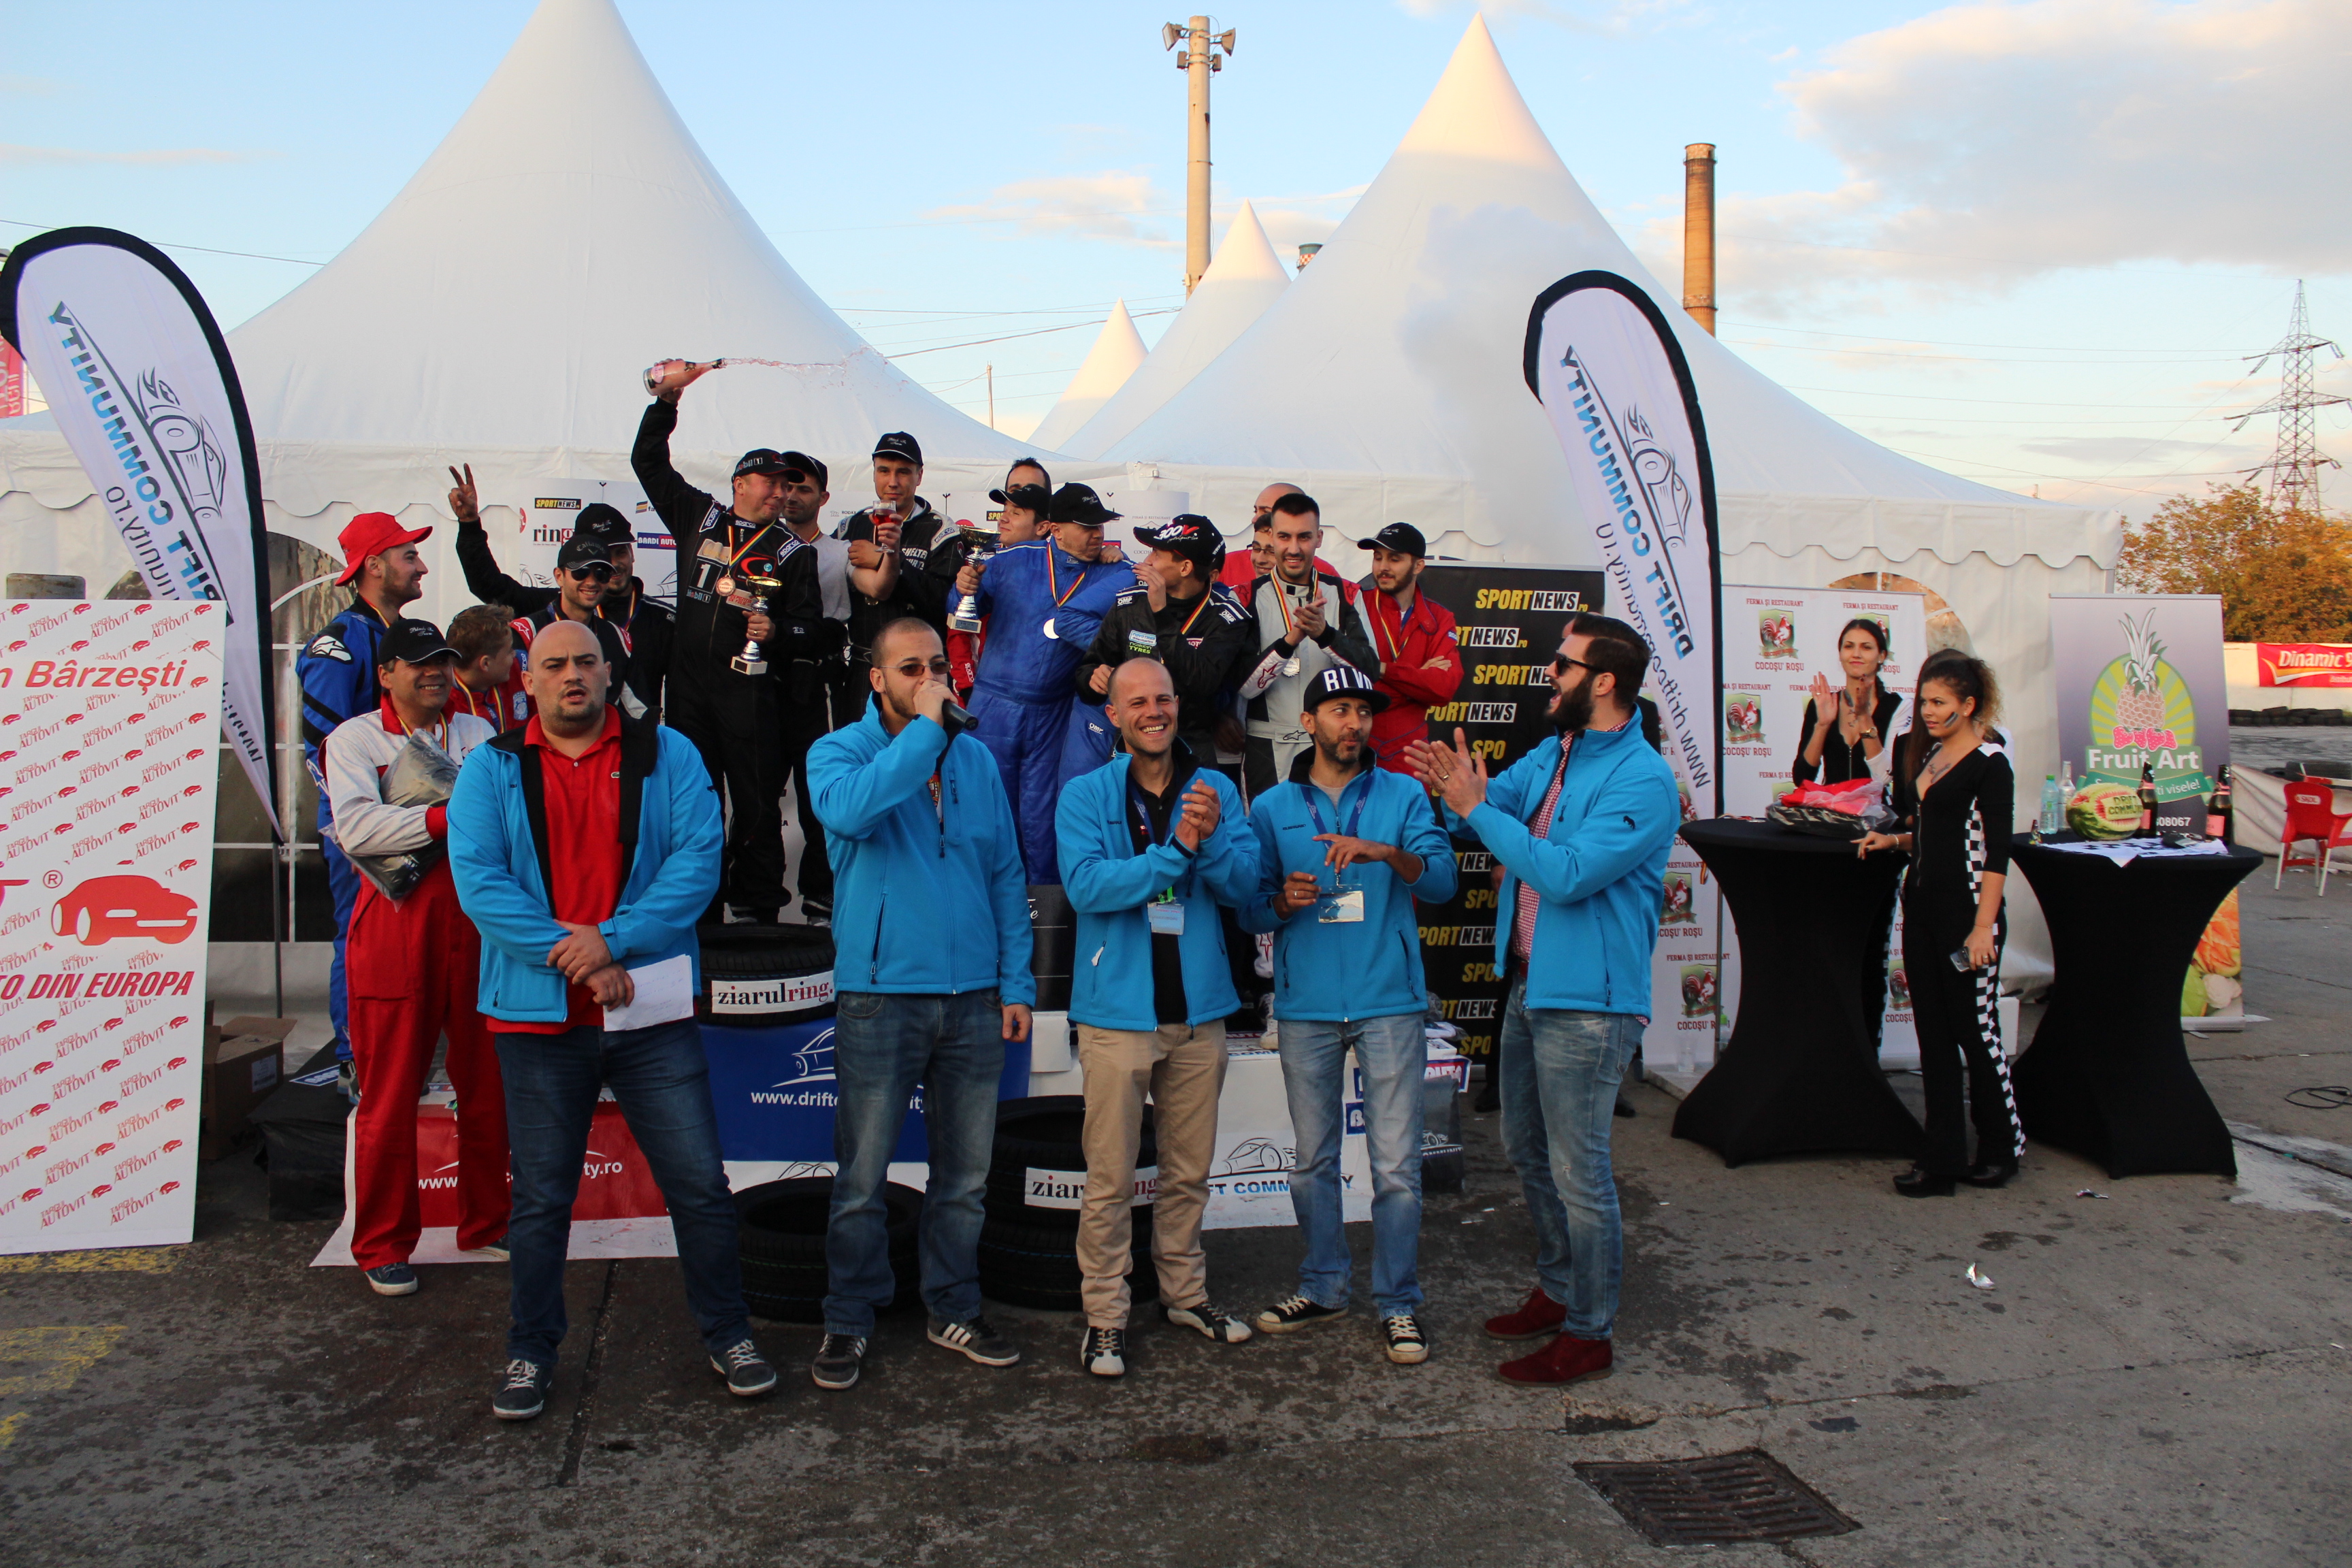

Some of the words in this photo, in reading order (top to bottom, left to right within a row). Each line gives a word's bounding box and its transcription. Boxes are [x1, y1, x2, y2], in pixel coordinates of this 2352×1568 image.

[735, 520, 756, 528] sparco
[780, 540, 800, 556] sparco
[697, 563, 711, 589] 1
[1117, 596, 1132, 606] OMP
[28, 616, 51, 630] TARGUL
[90, 616, 113, 630] TARGUL
[151, 616, 174, 630] TARGUL
[1221, 610, 1235, 623] OMP
[29, 612, 69, 640] AUTOVIT
[91, 612, 131, 640] AUTOVIT
[152, 612, 191, 640] AUTOVIT
[2278, 651, 2343, 668] Dinamic
[18, 725, 42, 740] TARGUL
[19, 721, 61, 750] AUTOVIT
[82, 725, 105, 740] TARGUL
[82, 721, 123, 750] AUTOVIT
[144, 725, 167, 739] TARGUL
[144, 720, 184, 749] AUTOVIT
[2089, 749, 2149, 769] Fruit
[2157, 750, 2200, 770] Art
[15, 762, 38, 777] TARGUL
[15, 757, 58, 787] AUTOVIT
[79, 762, 102, 776] TARGUL
[80, 757, 120, 786] AUTOVIT
[141, 762, 164, 776] TARGUL
[142, 757, 182, 785] AUTOVIT
[2166, 779, 2201, 795] visele!
[10, 799, 34, 814] TARGUL
[11, 794, 54, 823] AUTOVIT
[75, 798, 99, 813] TARGUL
[76, 794, 117, 823] AUTOVIT
[138, 798, 161, 813] TARGUL
[139, 794, 179, 822] AUTOVIT
[6, 836, 29, 851] TARGUL
[6, 832, 50, 861] AUTOVIT
[71, 836, 95, 850] TARGUL
[71, 830, 114, 860] AUTOVIT
[135, 835, 159, 849] TARGUL
[136, 830, 177, 860] AUTOVIT
[27, 973, 84, 999] DIN
[84, 971, 195, 998] EUROPA
[55, 1032, 79, 1049] TARGUL
[56, 1028, 99, 1061] AUTOVIT
[122, 1031, 145, 1047] TARGUL
[122, 1025, 165, 1058] AUTOVIT
[52, 1074, 76, 1090] TARGUL
[52, 1068, 97, 1102] AUTOVIT
[119, 1072, 143, 1089] TARGUL
[120, 1066, 163, 1100] AUTOVIT
[48, 1116, 73, 1133] TARGUL
[49, 1111, 93, 1144] AUTOVIT
[117, 1113, 141, 1130] TARGUL
[118, 1108, 160, 1142] AUTOVIT
[44, 1159, 69, 1176] TARGUL
[45, 1152, 91, 1187] AUTOVIT
[113, 1156, 137, 1173] TARGUL
[114, 1149, 158, 1184] AUTOVIT
[40, 1200, 65, 1218] TARGUL
[41, 1194, 87, 1230] AUTOVIT
[110, 1197, 135, 1214] TARGUL
[110, 1192, 155, 1226] AUTOVIT
